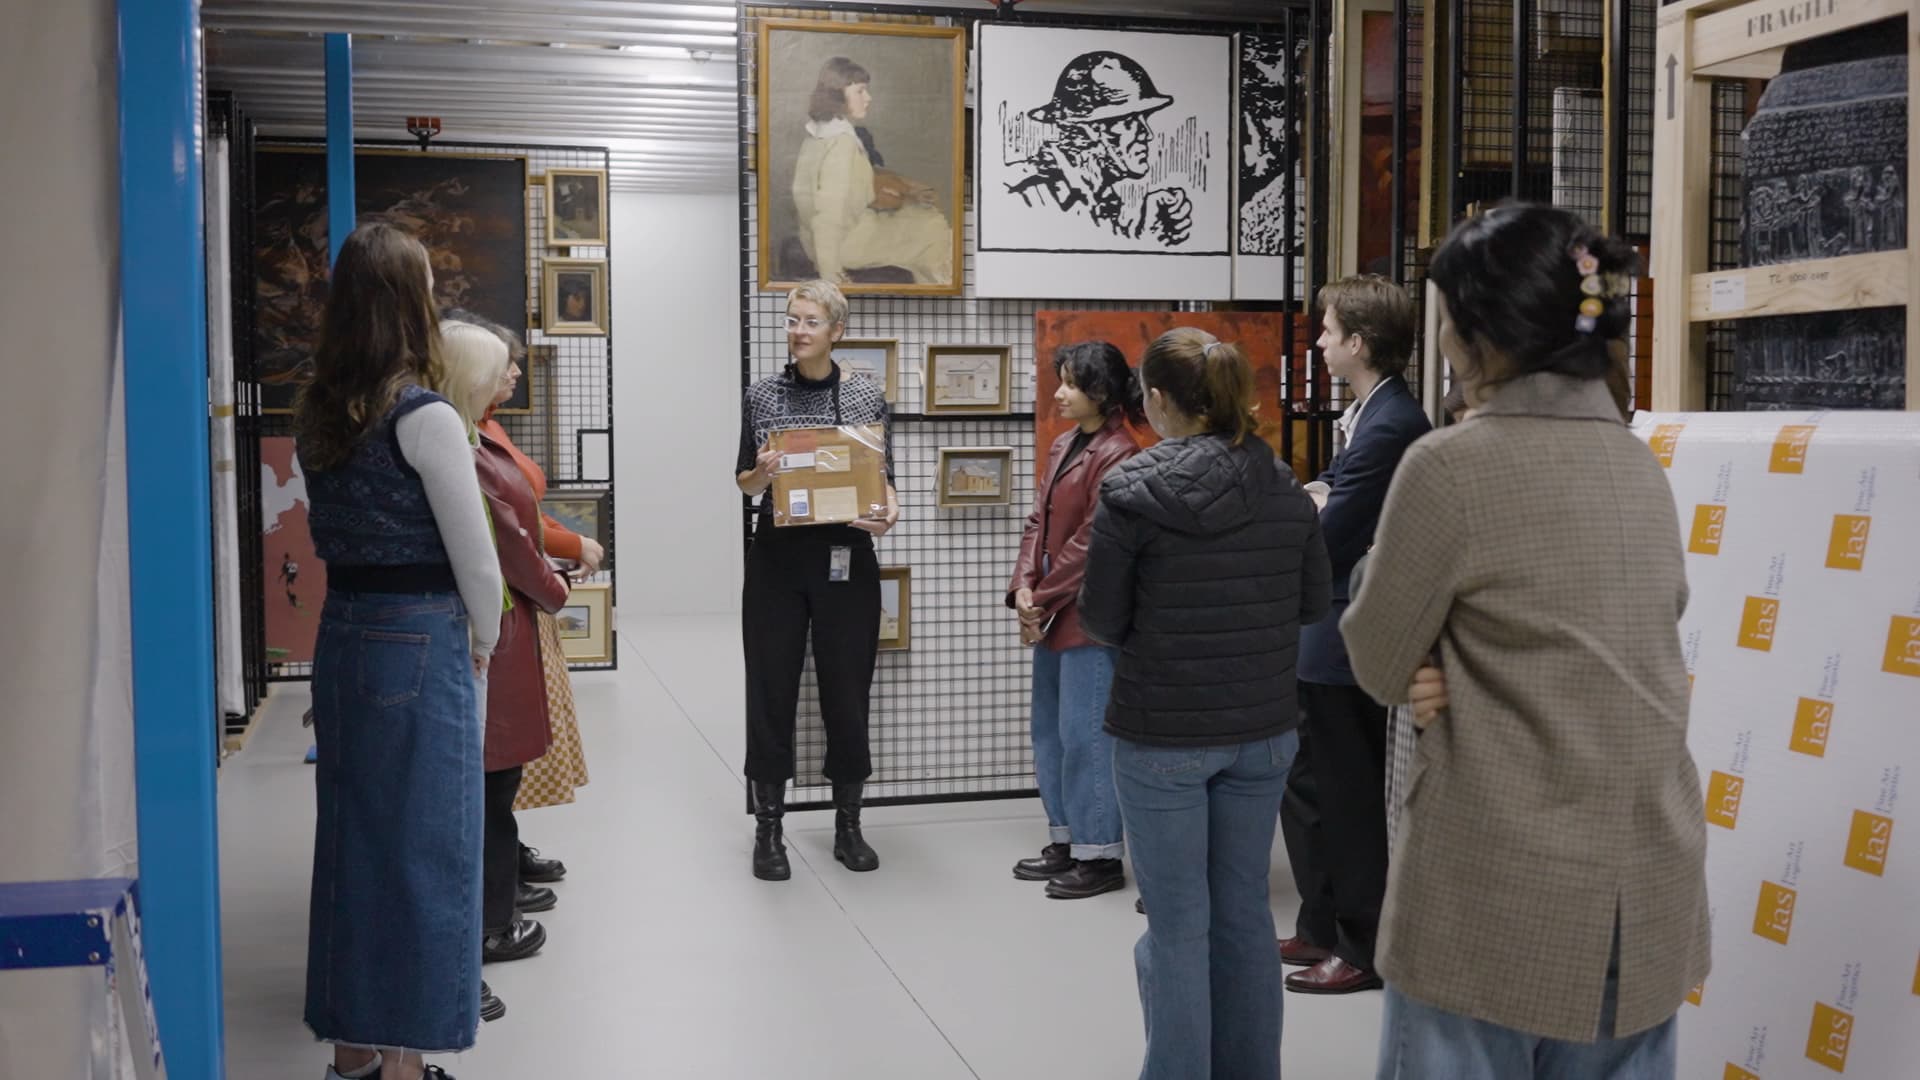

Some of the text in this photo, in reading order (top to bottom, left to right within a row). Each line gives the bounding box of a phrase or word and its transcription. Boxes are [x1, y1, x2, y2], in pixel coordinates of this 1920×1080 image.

[1747, 0, 1841, 38] FRAGILE
[1781, 429, 1811, 463] ias
[1700, 509, 1724, 545] ias
[1840, 519, 1868, 560] ias
[1750, 602, 1776, 641] ias
[1803, 704, 1831, 746] ias
[1715, 779, 1740, 820] ias
[1859, 819, 1888, 864] ias
[1766, 891, 1793, 933] ias
[1820, 1015, 1850, 1058] ias
